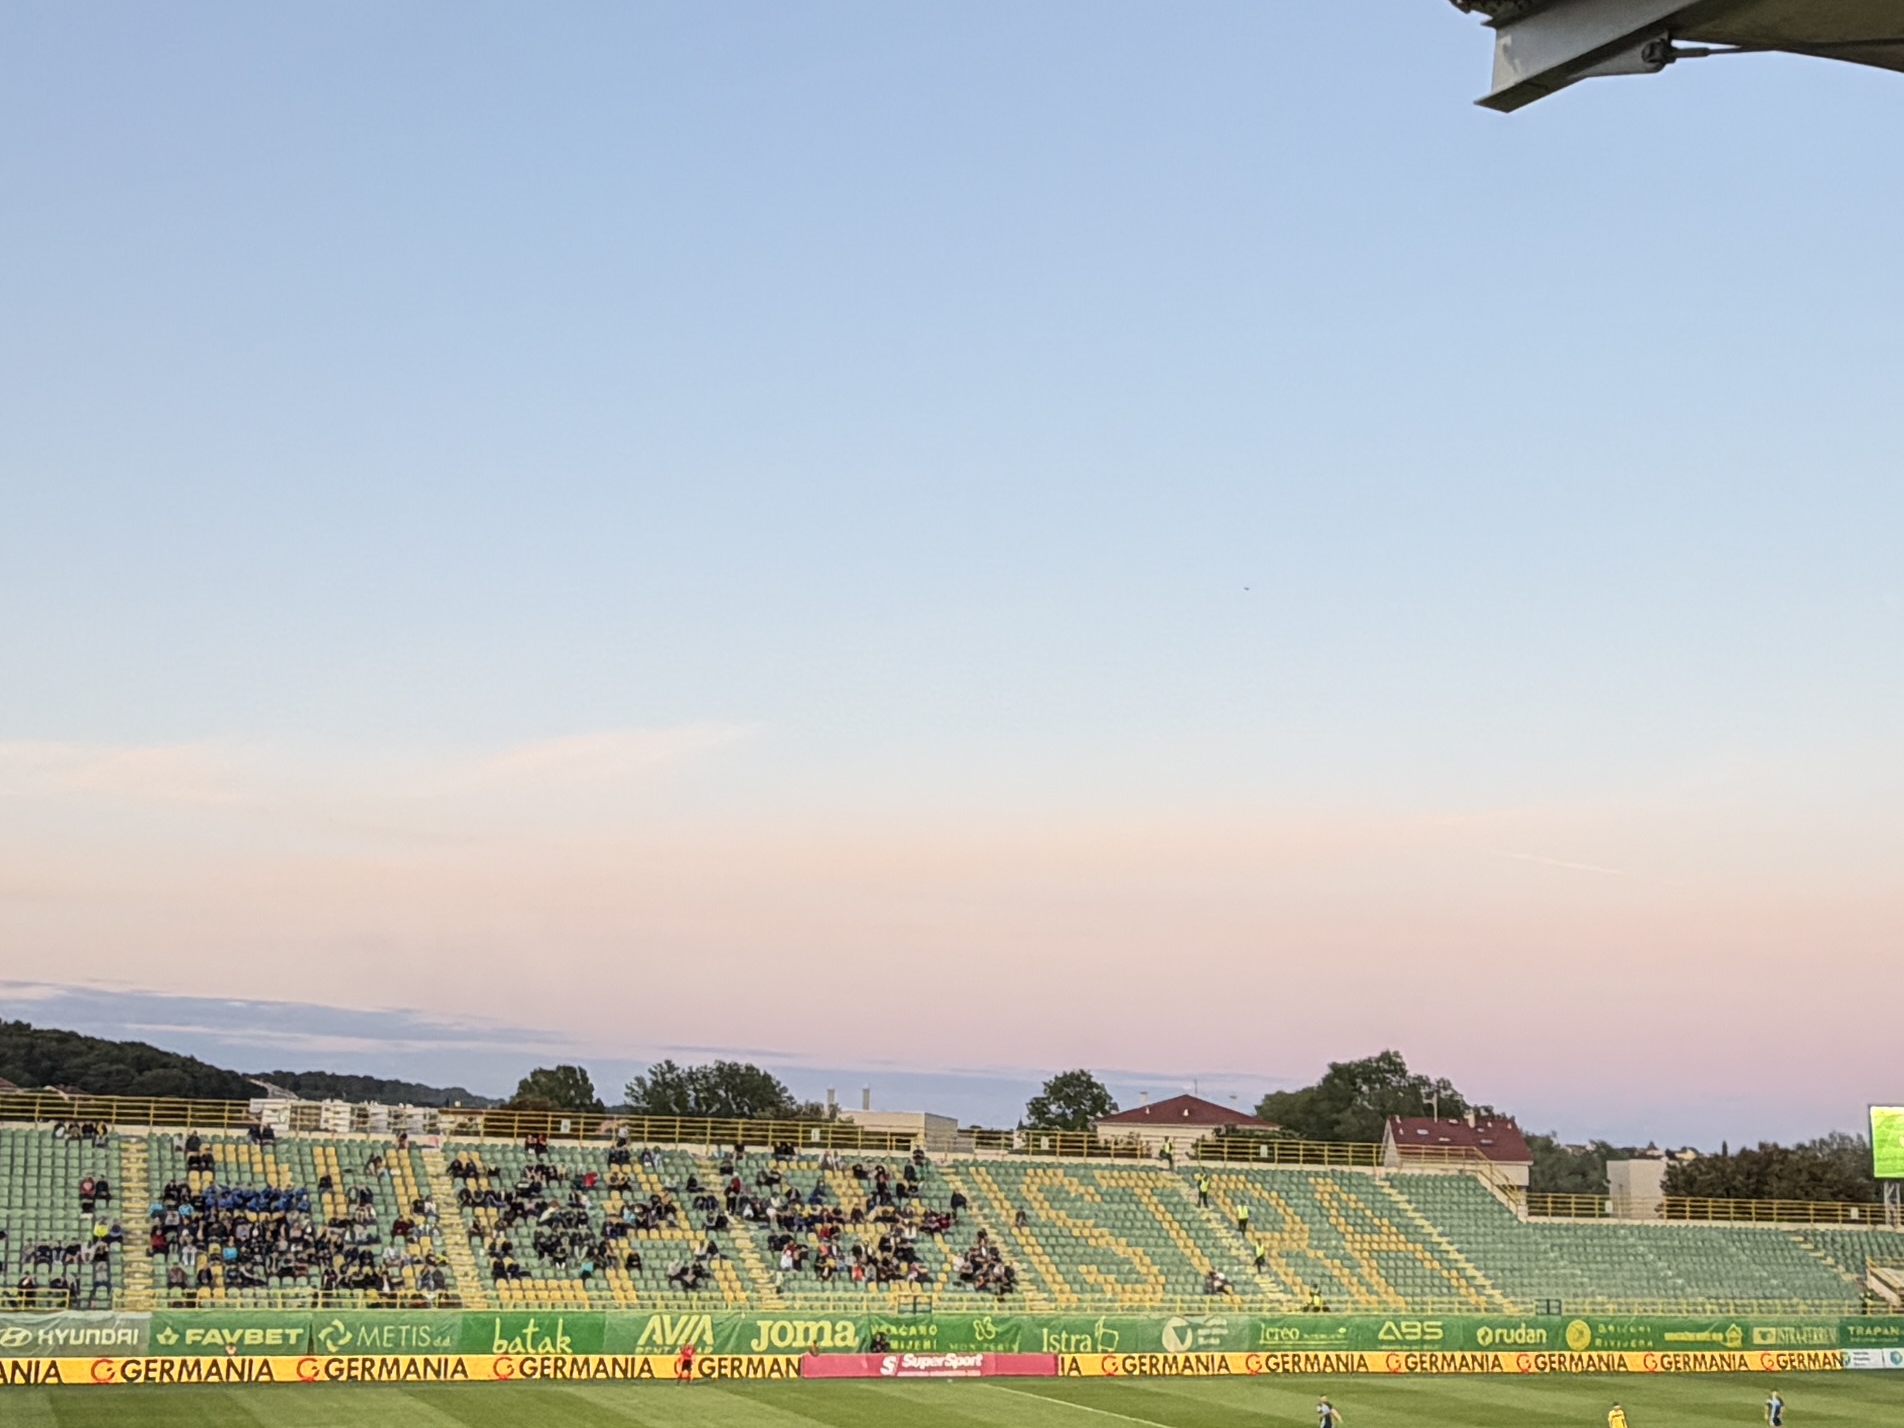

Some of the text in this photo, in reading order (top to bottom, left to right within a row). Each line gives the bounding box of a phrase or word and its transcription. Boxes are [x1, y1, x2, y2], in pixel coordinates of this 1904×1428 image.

[37, 1328, 139, 1346] HYUNDAI
[184, 1328, 304, 1346] FAVBET
[356, 1324, 431, 1348] METIS
[492, 1316, 574, 1355] batak
[635, 1314, 715, 1346] AVIA
[1041, 1327, 1092, 1353] Istra
[1495, 1322, 1547, 1345] rudan
[120, 1358, 274, 1383] GERMANIA
[324, 1357, 469, 1382] GERMANIA
[518, 1356, 656, 1381] GERMANIA
[697, 1356, 802, 1379] GERMAN
[901, 1352, 983, 1369] SuperSport
[1060, 1355, 1082, 1377] IA
[1121, 1353, 1231, 1376] GERMANIA
[1264, 1352, 1369, 1375] GERMANIA
[1404, 1352, 1504, 1373] GERMANIA
[1533, 1352, 1630, 1373] GERMANIA
[1660, 1352, 1748, 1372] GERMANIA
[1775, 1351, 1843, 1372] GERMAN
